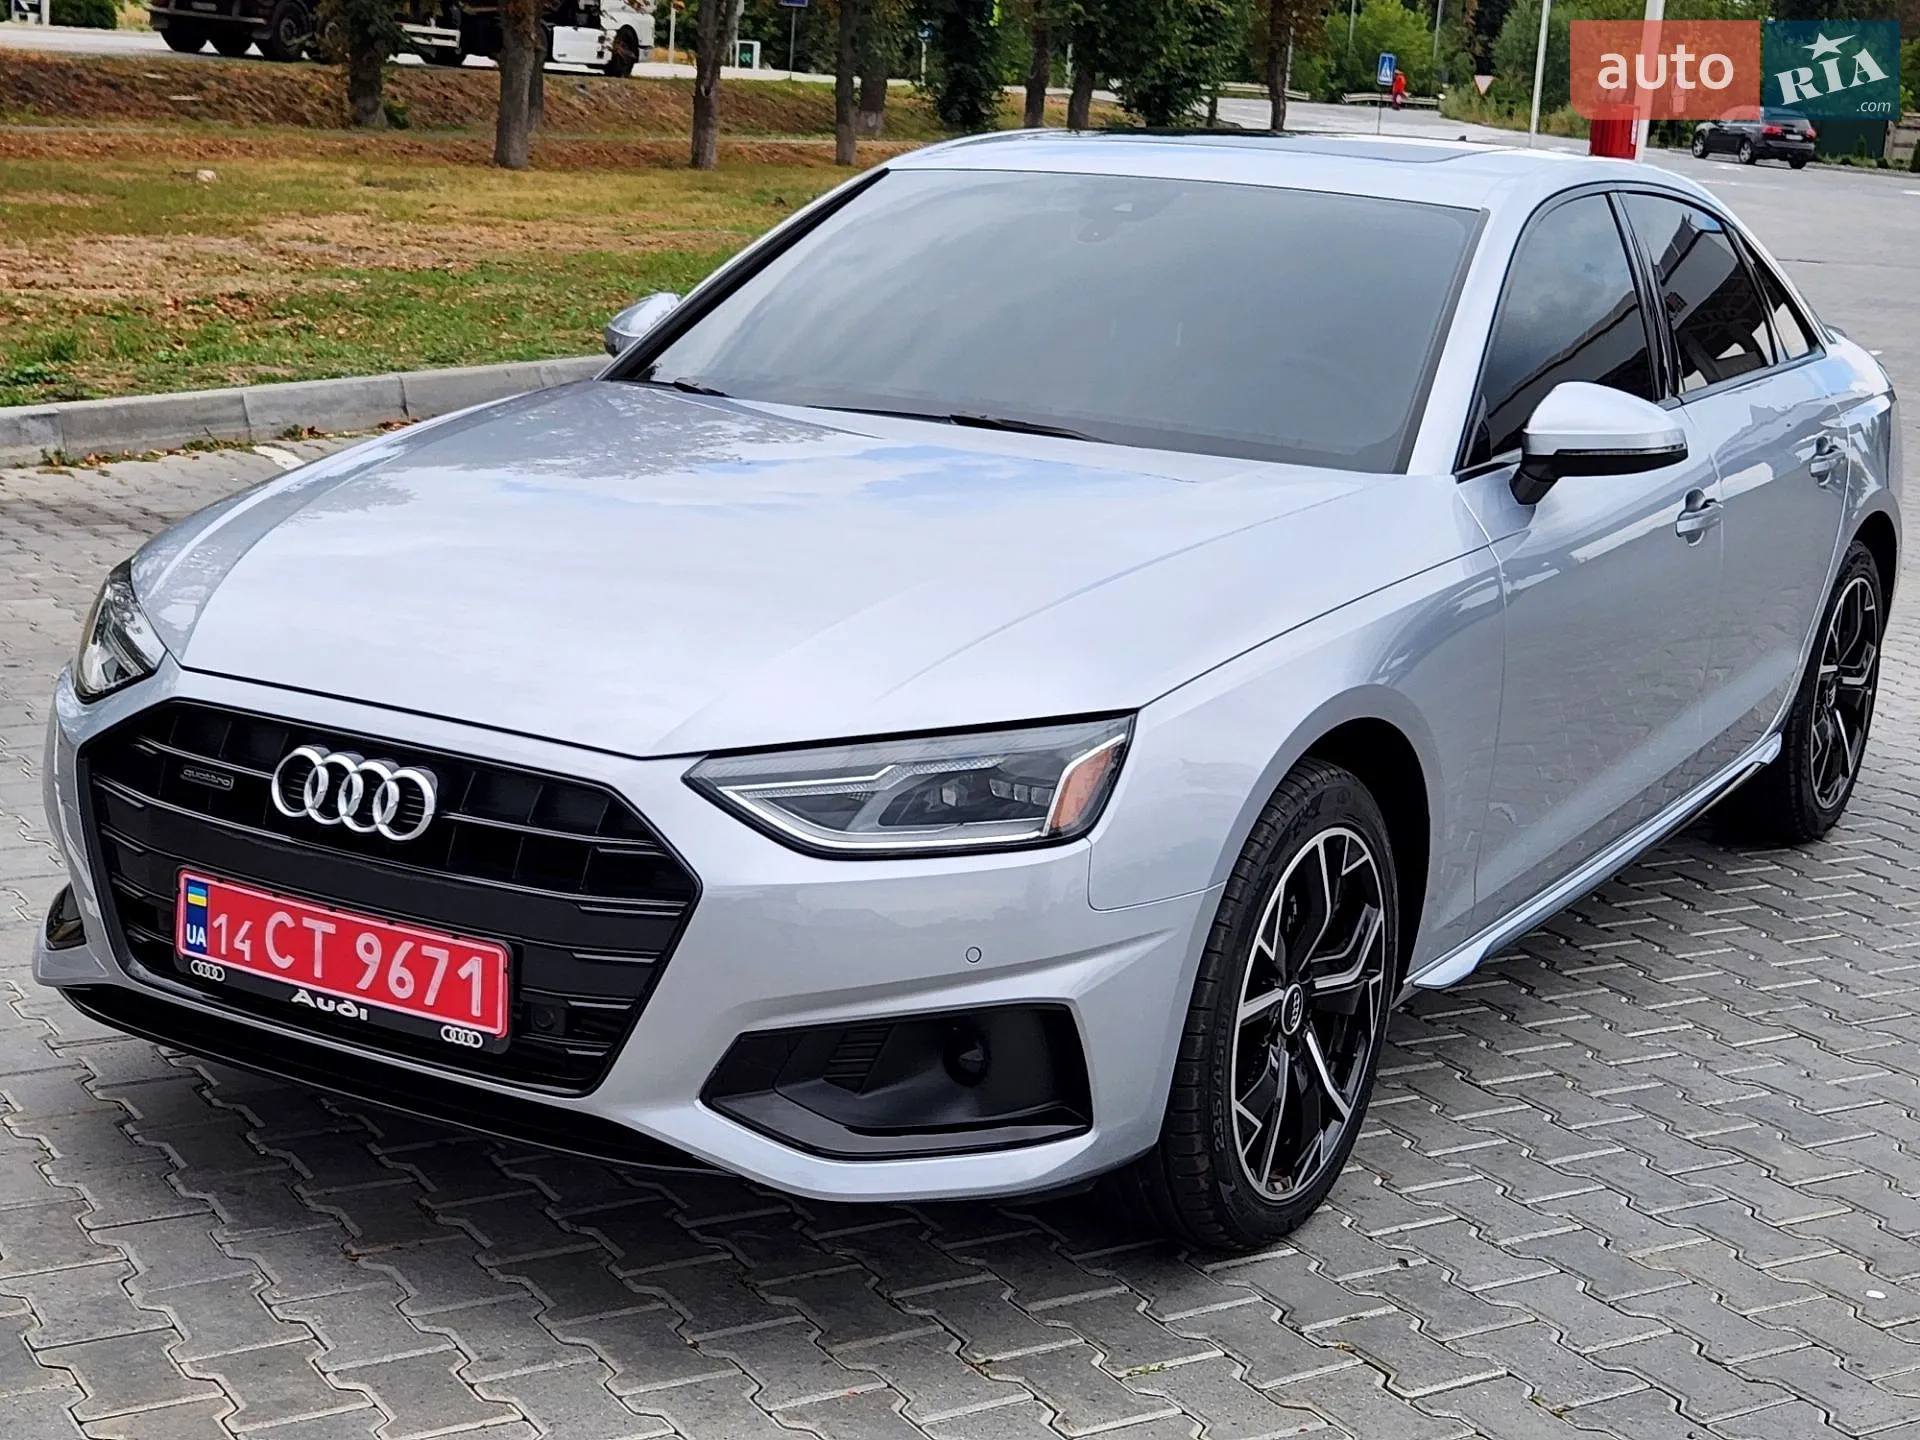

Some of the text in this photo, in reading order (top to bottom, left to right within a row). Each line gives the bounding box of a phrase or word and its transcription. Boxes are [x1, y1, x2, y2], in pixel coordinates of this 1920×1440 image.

[186, 922, 207, 947] UA
[212, 911, 482, 1017] 14 CT 9671
[290, 988, 368, 1021] Audi
